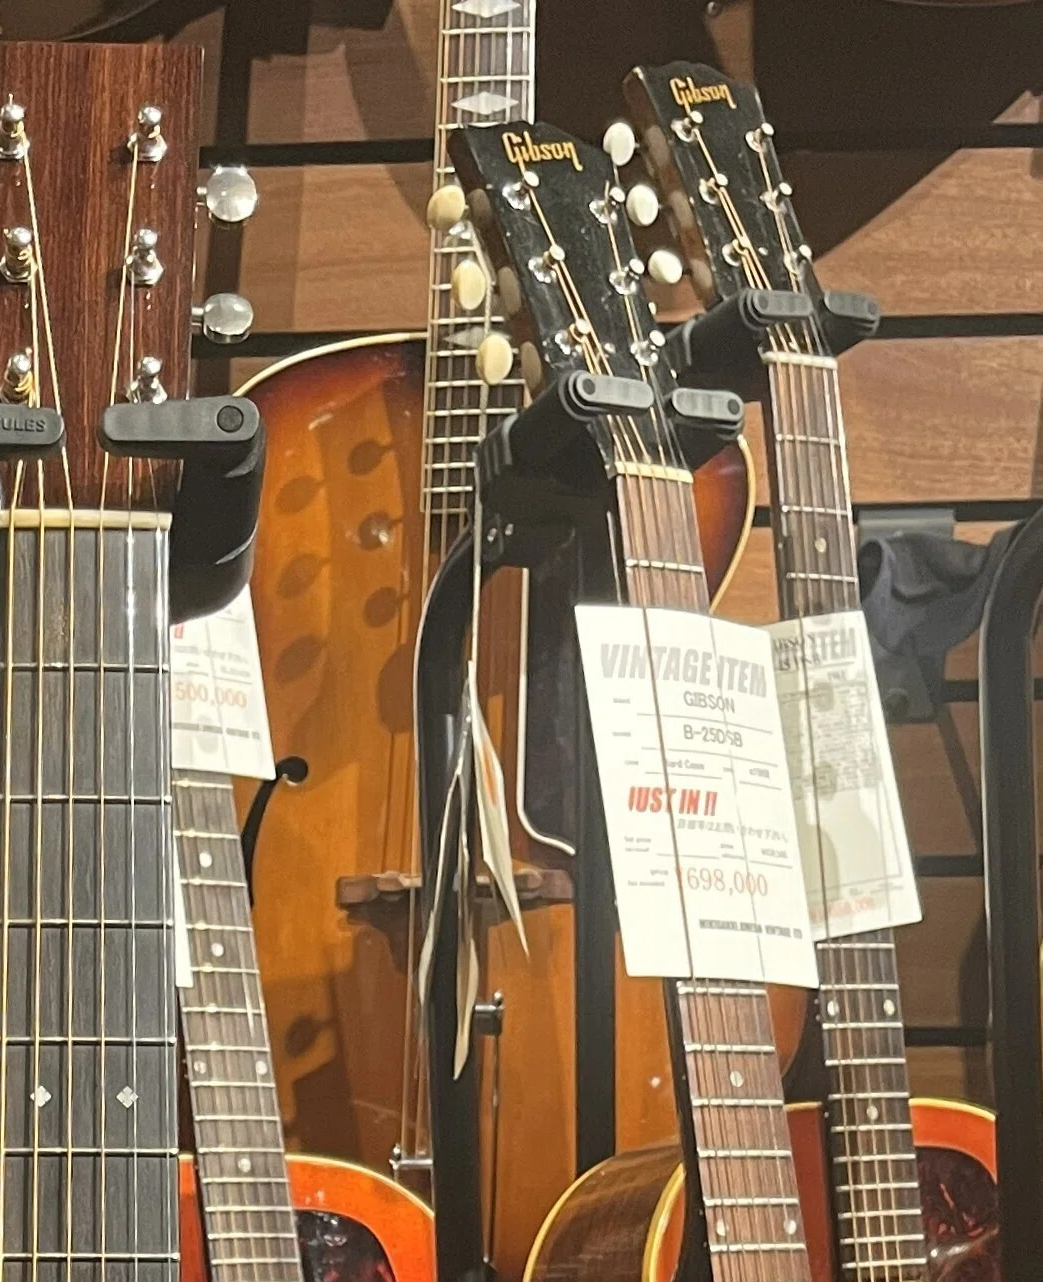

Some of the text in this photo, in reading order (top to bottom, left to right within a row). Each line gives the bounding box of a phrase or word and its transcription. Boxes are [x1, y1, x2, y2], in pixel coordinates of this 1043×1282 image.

[670, 76, 737, 111] Gibson
[502, 130, 583, 171] Gibson
[600, 643, 767, 698] VINTAGE ITEM
[683, 690, 736, 714] GIBSON
[678, 788, 701, 815] IN
